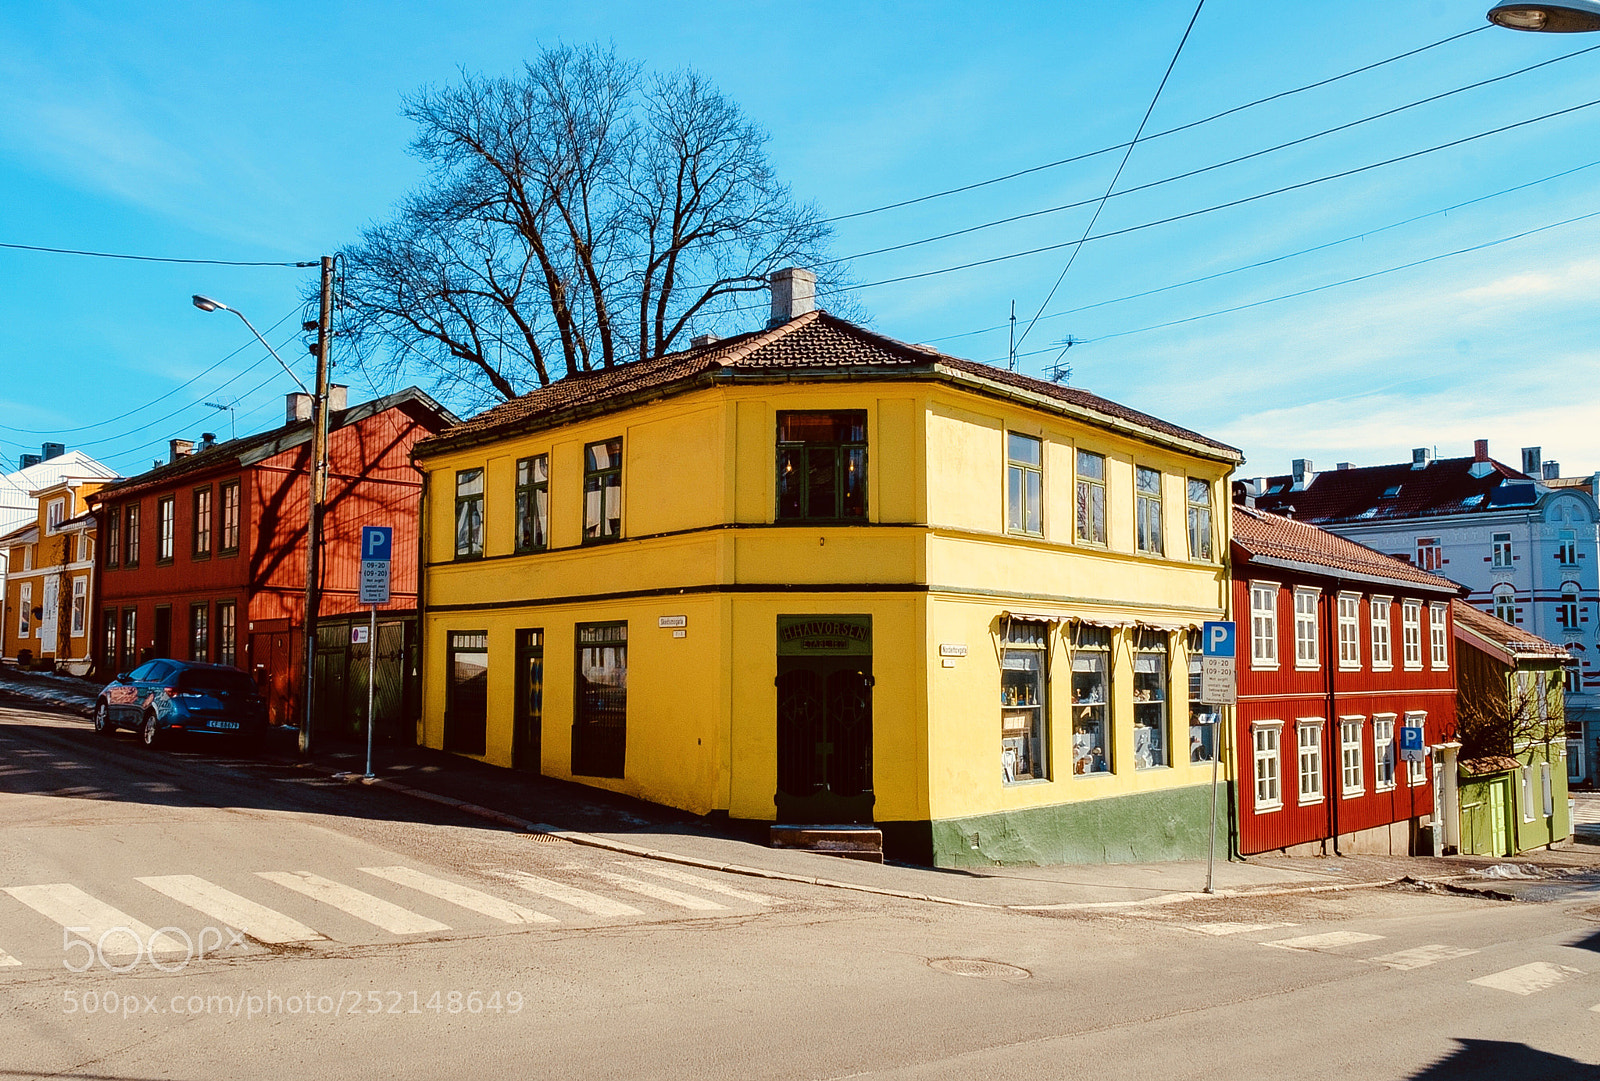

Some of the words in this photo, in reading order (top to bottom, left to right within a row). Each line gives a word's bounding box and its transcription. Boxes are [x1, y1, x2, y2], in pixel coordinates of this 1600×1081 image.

[368, 530, 385, 556] P
[1210, 625, 1228, 652] P
[1405, 730, 1417, 747] P
